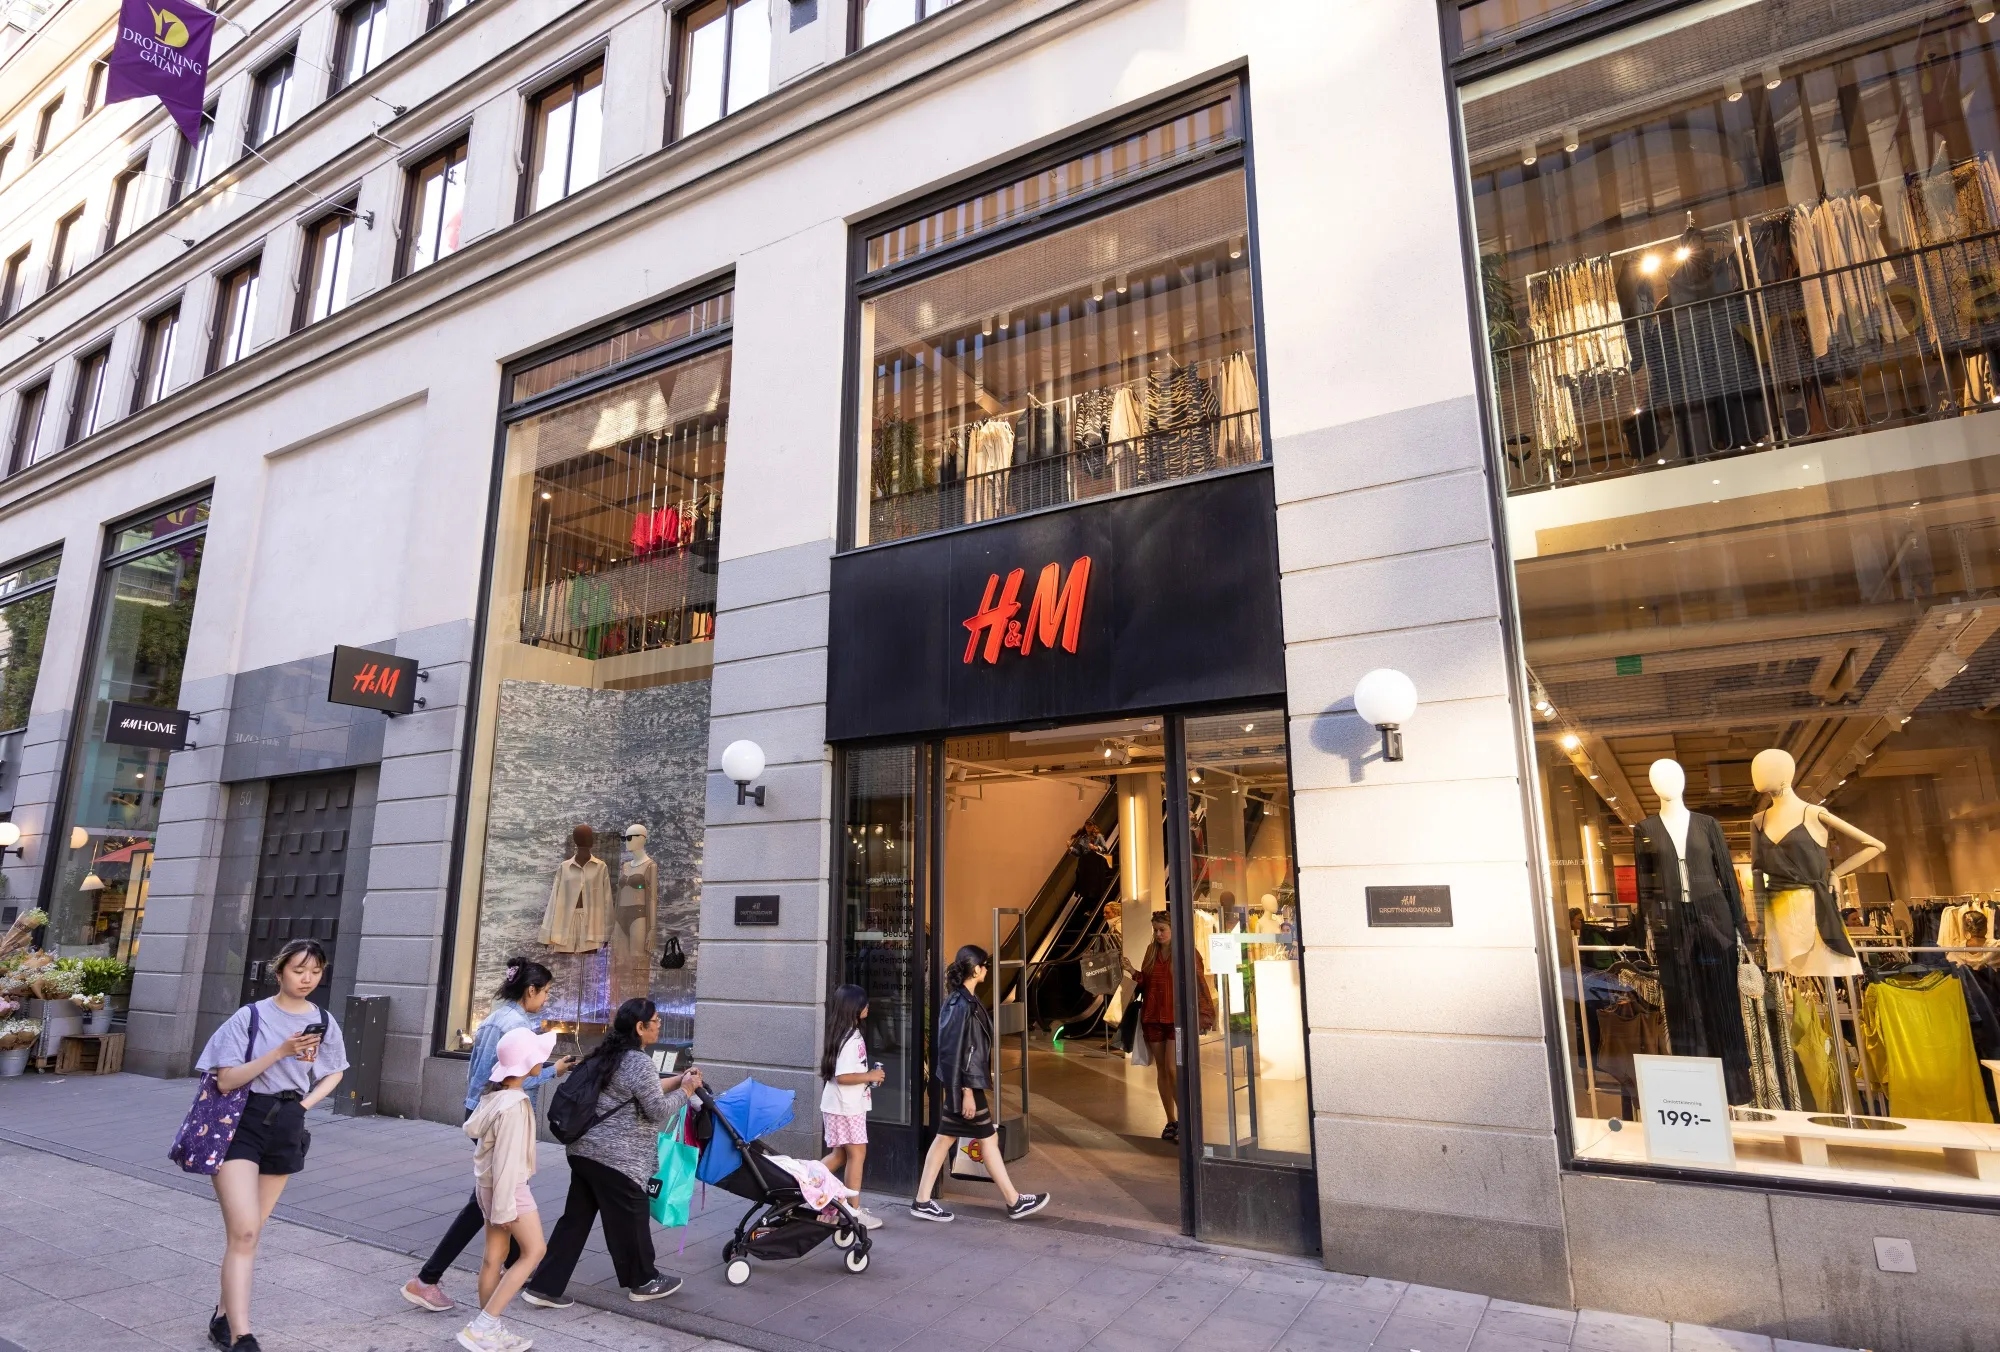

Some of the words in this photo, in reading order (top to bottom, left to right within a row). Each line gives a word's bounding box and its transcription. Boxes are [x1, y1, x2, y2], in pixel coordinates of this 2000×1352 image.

[122, 27, 202, 76] DROTTNING
[140, 49, 183, 78] GATAN
[962, 555, 1092, 665] H&M
[352, 662, 401, 699] H&M
[138, 719, 178, 735] HOME
[239, 791, 252, 806] 50
